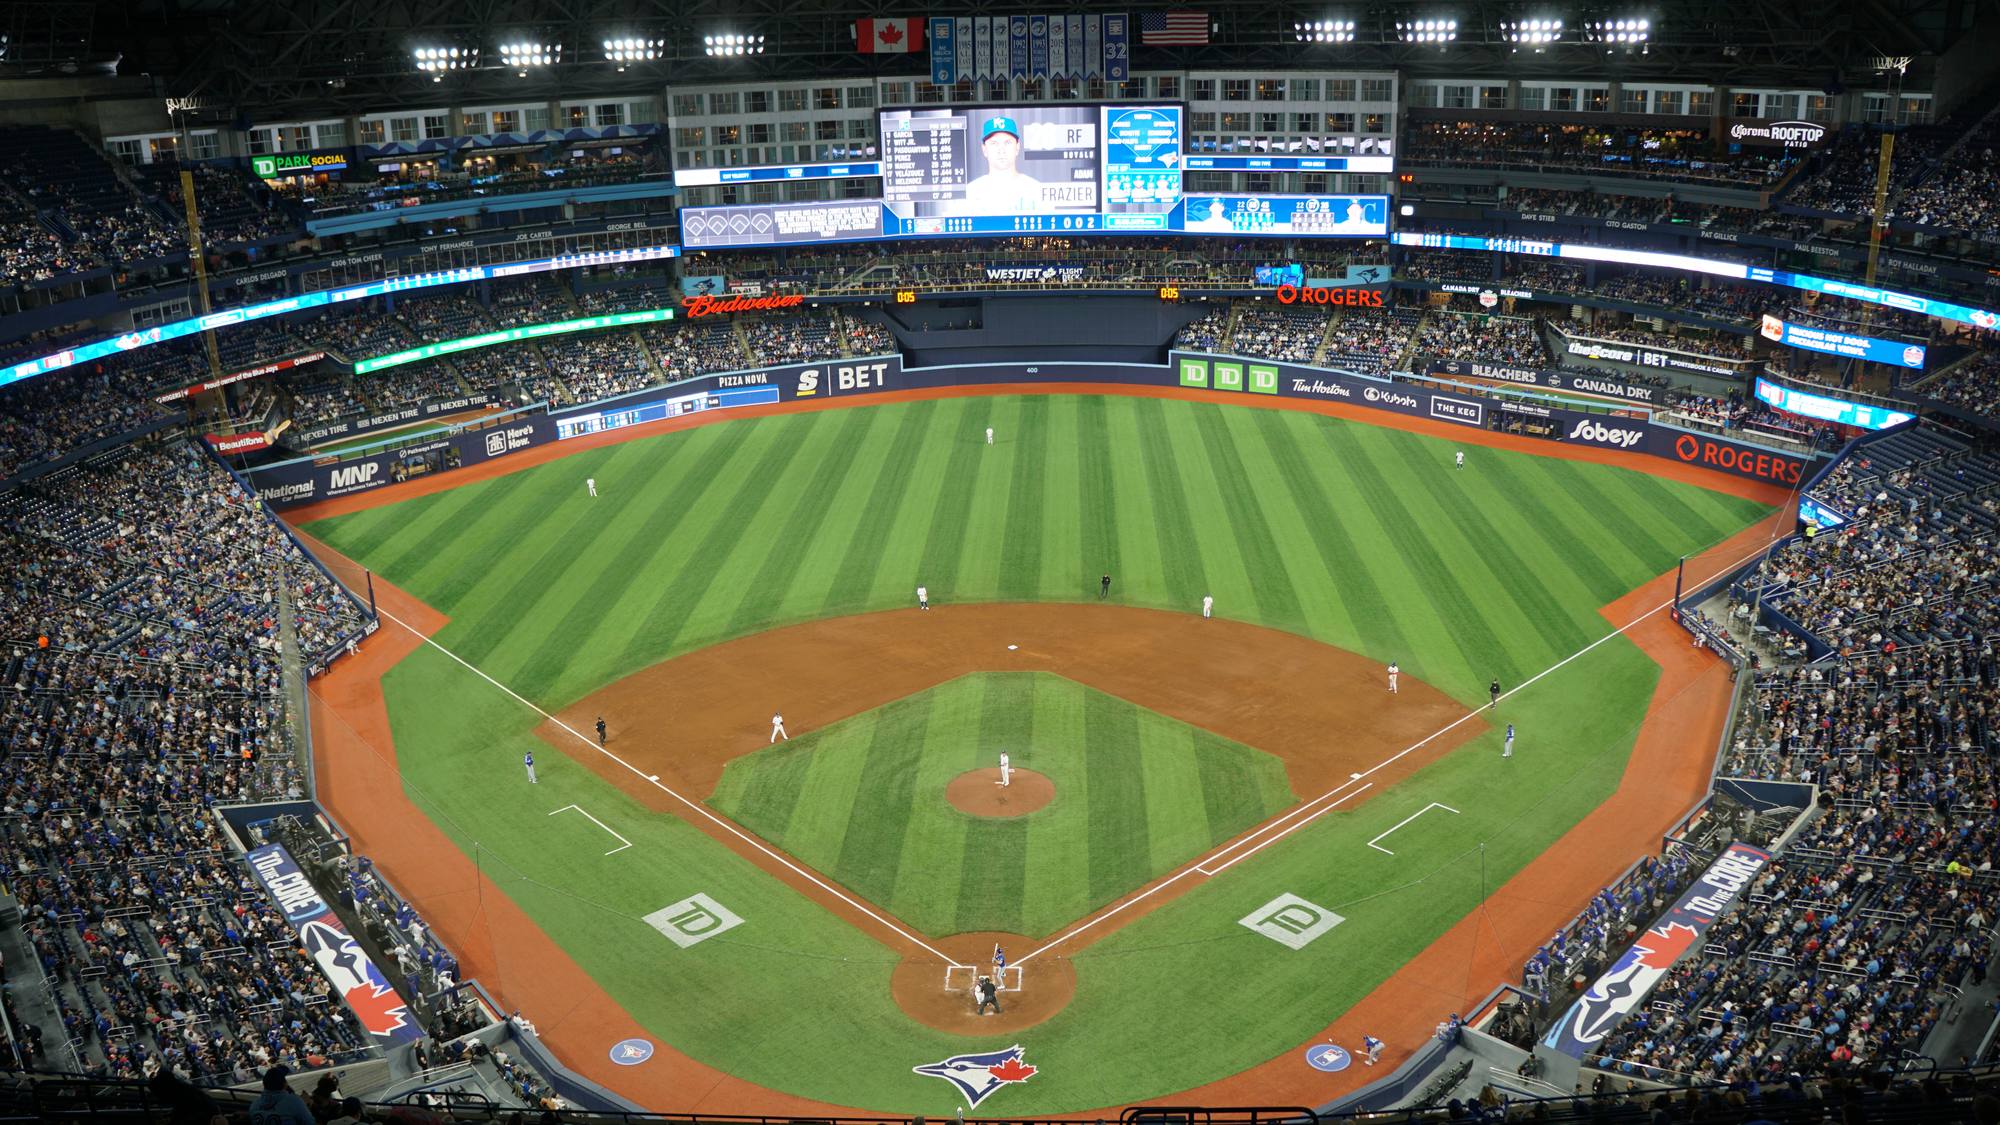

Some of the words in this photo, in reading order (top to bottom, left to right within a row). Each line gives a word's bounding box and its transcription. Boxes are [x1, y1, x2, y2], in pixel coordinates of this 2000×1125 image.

[1013, 40, 1026, 49] 1992
[1032, 40, 1046, 49] 1993
[1050, 39, 1064, 48] 2015
[1105, 42, 1127, 59] 32
[1067, 129, 1083, 144] RF
[1731, 124, 1770, 139] Corona
[1771, 127, 1824, 141] ROOFTOP
[255, 160, 274, 174] TD
[276, 155, 311, 167] PARK
[312, 155, 346, 166] SOCIAL
[1074, 170, 1094, 179] ADAM
[1041, 187, 1093, 202] FRAZIER
[1088, 217, 1094, 228] 2
[1538, 214, 1556, 222] STIEB
[1606, 220, 1620, 228] CITO
[1622, 222, 1648, 231] GASTON
[530, 231, 553, 240] CARTER
[1700, 231, 1713, 239] PAT
[1714, 233, 1738, 242] GILLICK
[421, 245, 437, 253] TONY
[440, 240, 474, 251] FERNANDEZ
[1794, 243, 1810, 252] PAUL
[1811, 246, 1840, 257] BEESTON
[350, 257, 364, 266] TOM
[364, 253, 383, 264] CHEEK
[1888, 259, 1902, 268] ROY
[1903, 261, 1937, 273] HALLADAY
[236, 275, 259, 286] CARLOS
[260, 269, 287, 281] DELGADO
[987, 269, 1042, 282] WESTJET
[898, 292, 915, 303] 0:05
[1161, 288, 1179, 299] 0:05
[1301, 287, 1383, 307] ROGERS
[1500, 289, 1532, 298] BLEACHERS
[681, 291, 804, 318] Budweiser
[1824, 334, 1843, 343] HOT
[299, 355, 318, 366] ROGERS
[1568, 342, 1633, 362] theScore
[1644, 353, 1669, 368] BET
[1671, 360, 1706, 371] SPORTSBOOK
[1712, 367, 1734, 376] CASINO
[204, 380, 220, 391] Proud
[220, 377, 236, 385] owner
[253, 369, 265, 377] Blue
[265, 365, 278, 375] Jays
[719, 376, 742, 388] PIZZA
[744, 373, 768, 386] NOVA
[839, 364, 888, 390] BET
[1184, 365, 1205, 382] TD
[1217, 368, 1240, 385] TD
[1251, 371, 1276, 389] TD
[1472, 364, 1537, 383] BLEACHERS
[1292, 379, 1313, 393] Tim
[1313, 380, 1350, 397] Hortons
[1573, 379, 1626, 398] CANADA
[440, 400, 468, 413] NEXEN
[469, 396, 488, 407] TIRE
[1380, 390, 1417, 408] Kubota
[371, 413, 399, 426] NEXEN
[400, 409, 419, 421] TIRE
[1437, 403, 1455, 413] THE
[1458, 406, 1476, 417] KEG
[301, 428, 328, 442] NEXEN
[329, 424, 348, 436] TIRE
[507, 425, 534, 439] Here's
[1570, 420, 1643, 448] Sobeys
[407, 447, 427, 457] Pathways
[428, 441, 449, 451] Alliance
[508, 438, 530, 450] How.
[1704, 443, 1800, 484] ROGERS
[331, 462, 379, 489] MNP
[264, 482, 314, 502] National
[326, 488, 348, 498] Wherever
[348, 485, 366, 494] Business
[366, 482, 377, 490] Takes
[282, 496, 292, 504] Car
[364, 620, 379, 636] VISA
[252, 851, 284, 873] TO
[262, 870, 279, 881] THE
[1702, 850, 1763, 891] CORE
[268, 872, 321, 911] CORE
[1712, 890, 1733, 904] THE
[1684, 897, 1716, 917] TO
[668, 901, 724, 937] TD
[1255, 904, 1322, 935] TD
